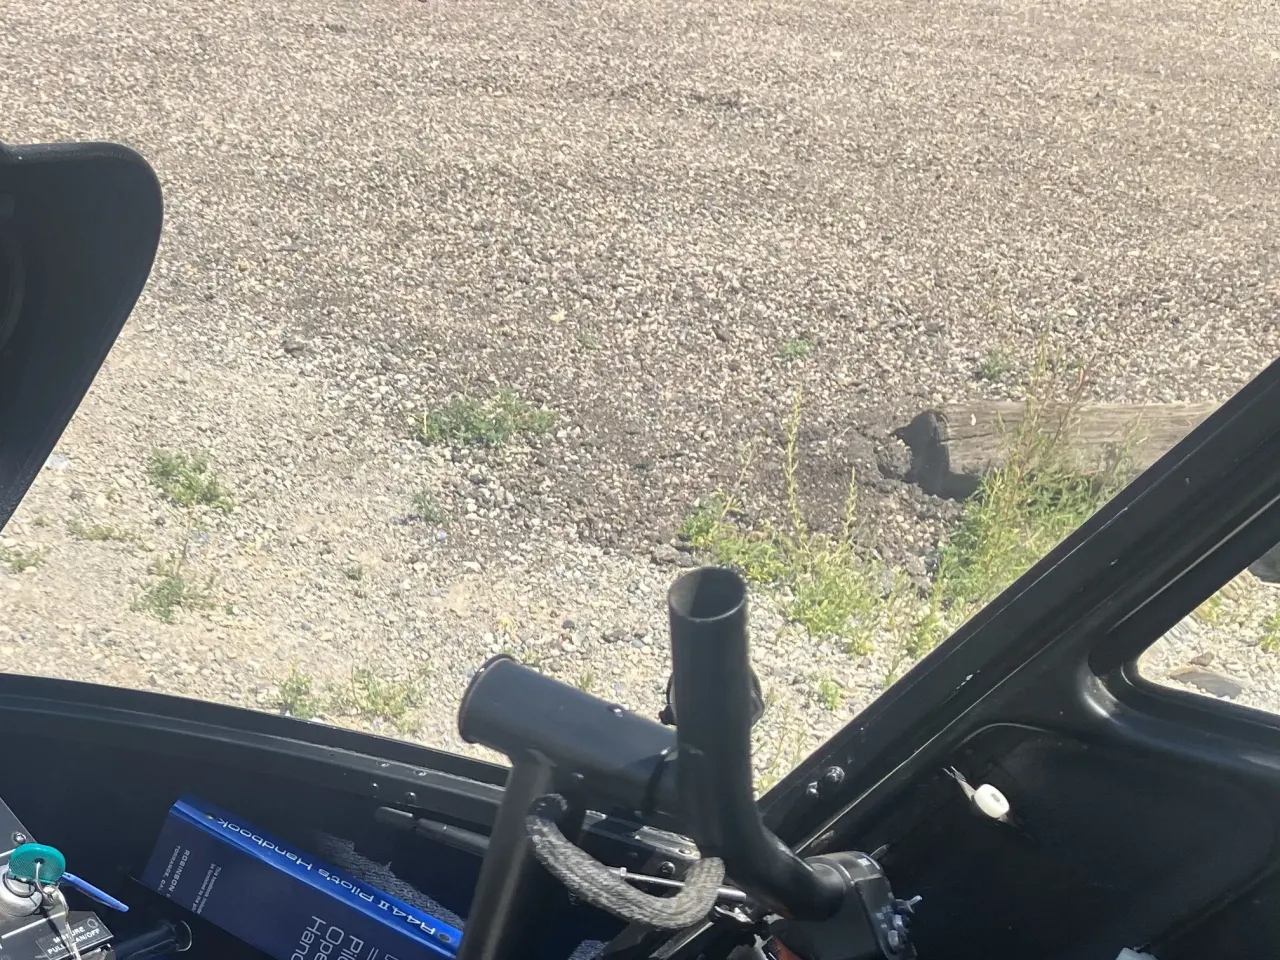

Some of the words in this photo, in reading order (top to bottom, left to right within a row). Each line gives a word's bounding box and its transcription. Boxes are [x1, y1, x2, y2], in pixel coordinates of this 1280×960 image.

[218, 816, 314, 871] Handbook
[168, 849, 191, 892] ROBINSON
[317, 868, 375, 903] Pilot's
[377, 899, 391, 911] II
[391, 905, 436, 935] R44
